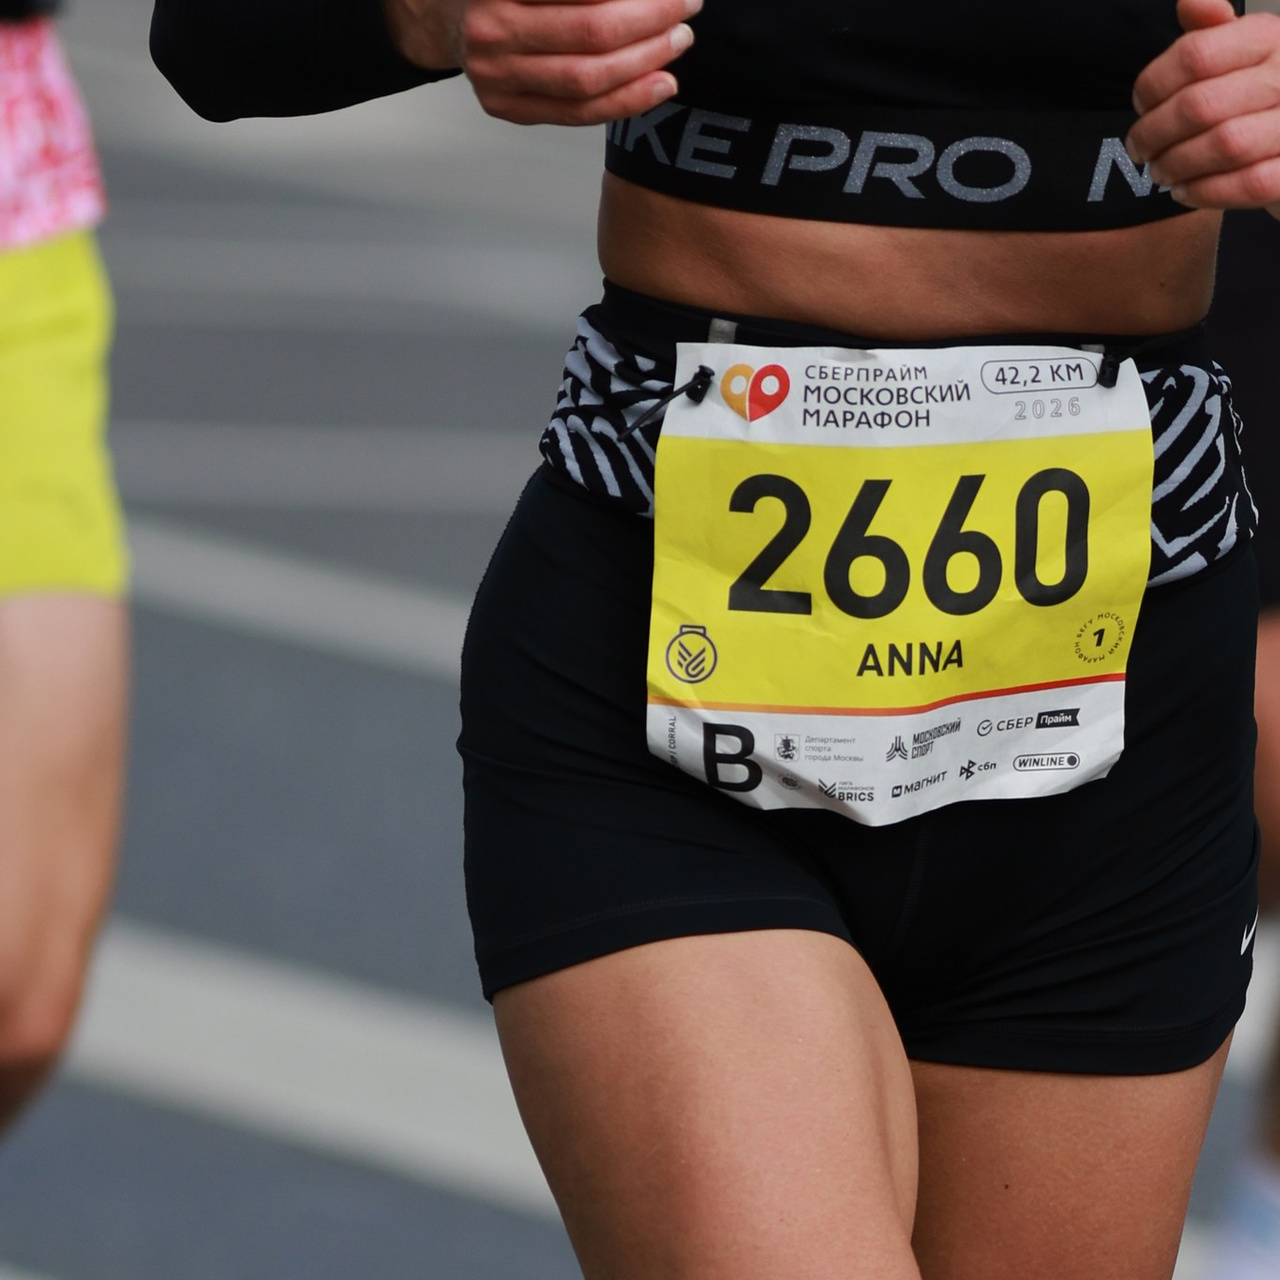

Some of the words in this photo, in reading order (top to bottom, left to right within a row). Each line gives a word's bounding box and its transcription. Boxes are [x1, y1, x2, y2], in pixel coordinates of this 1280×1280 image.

[605, 101, 751, 180] IKE
[760, 123, 1031, 203] PRO
[805, 364, 928, 382] СБЕРПРАЙМ
[995, 366, 1042, 387] 42,2
[1050, 363, 1084, 382] КМ
[803, 379, 971, 406] МОСКОВСКИЙ
[802, 408, 930, 429] МАРАФОН
[1014, 397, 1081, 421] 2026
[727, 467, 1090, 619] 2660
[1093, 628, 1105, 647] 1
[856, 639, 964, 677] ANNA
[996, 717, 1033, 732] СБЕР
[1040, 713, 1072, 725] Прайм
[667, 716, 676, 749] CORRAL
[805, 735, 856, 744] Департамент
[912, 718, 961, 746] МОСКОВСКИЙ
[833, 754, 864, 762] Москвы
[911, 740, 934, 760] СПОРТ
[977, 762, 997, 772] сбп
[1018, 756, 1065, 768] WINLINE
[838, 792, 875, 802] BRICS
